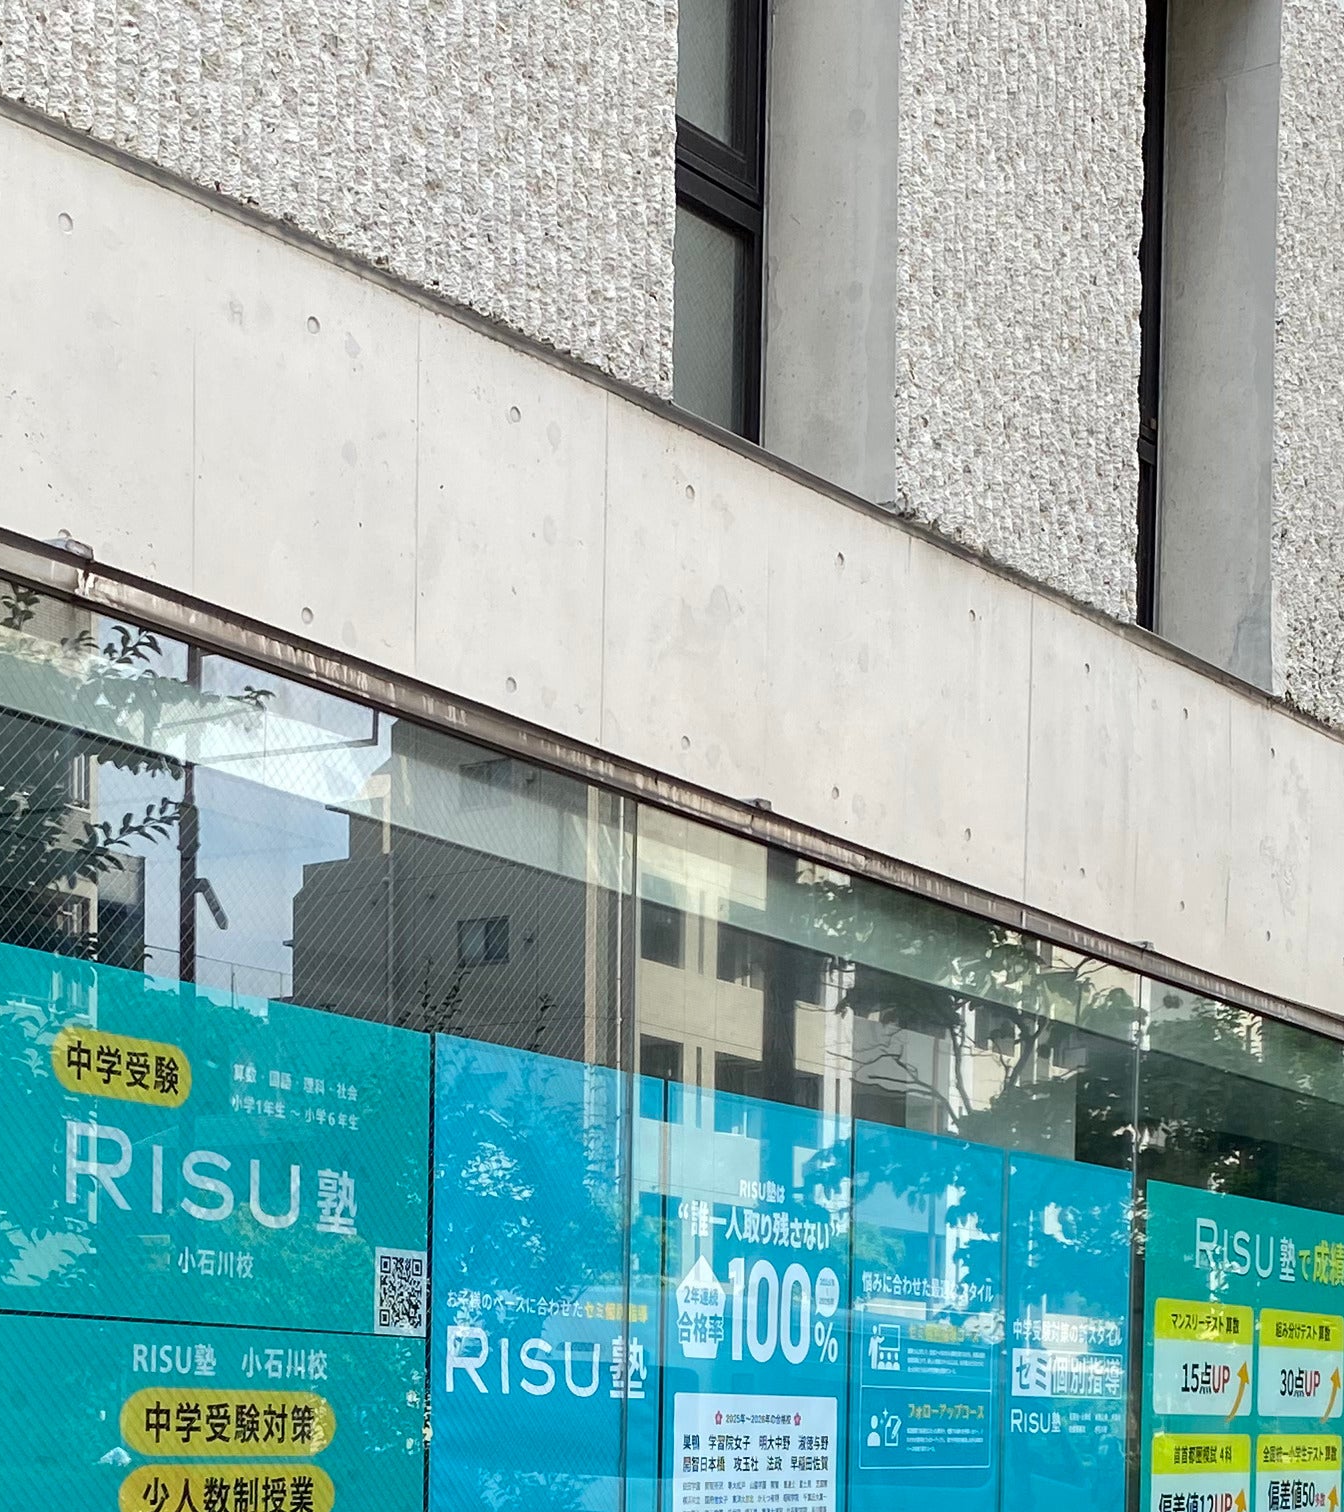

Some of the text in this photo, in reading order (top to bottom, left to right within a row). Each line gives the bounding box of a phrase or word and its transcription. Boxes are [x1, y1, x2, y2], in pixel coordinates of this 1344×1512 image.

[66, 1040, 180, 1095] 中学受験
[65, 1119, 358, 1236] RISU塾
[739, 1179, 786, 1204] RISU塾は
[177, 1246, 254, 1279] 小石川校
[677, 1311, 724, 1345] 合格率
[132, 1342, 328, 1381] RISU塾 小石川校
[445, 1325, 648, 1399] RISU塾
[1181, 1362, 1231, 1394] 15点UP
[1279, 1367, 1321, 1398] 30点UP
[144, 1400, 316, 1445] 中学受験対策
[1010, 1408, 1061, 1434] RISU塾
